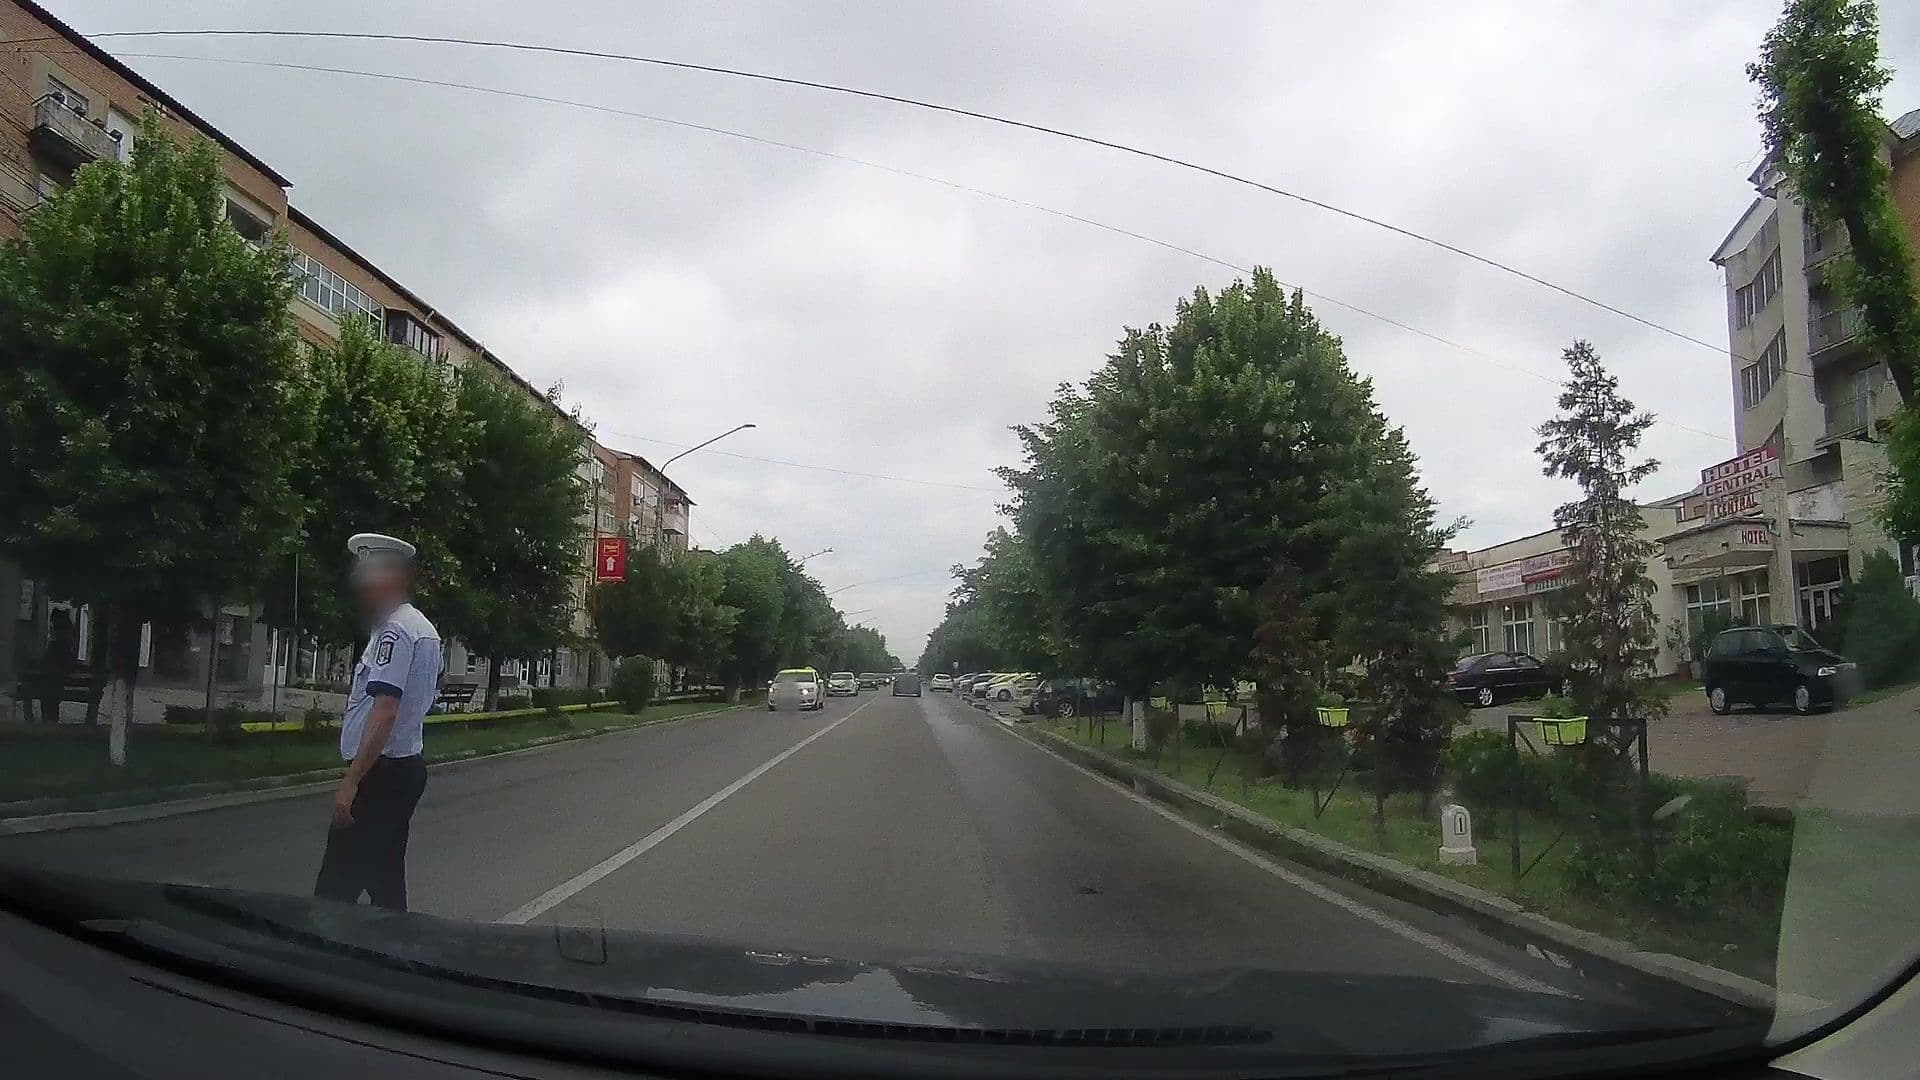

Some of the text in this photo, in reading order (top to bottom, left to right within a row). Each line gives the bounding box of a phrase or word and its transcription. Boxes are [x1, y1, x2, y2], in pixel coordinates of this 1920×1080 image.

[1704, 449, 1776, 483] HOTEL
[1706, 466, 1771, 496] CENTRAL
[1742, 530, 1768, 544] HOTEL
